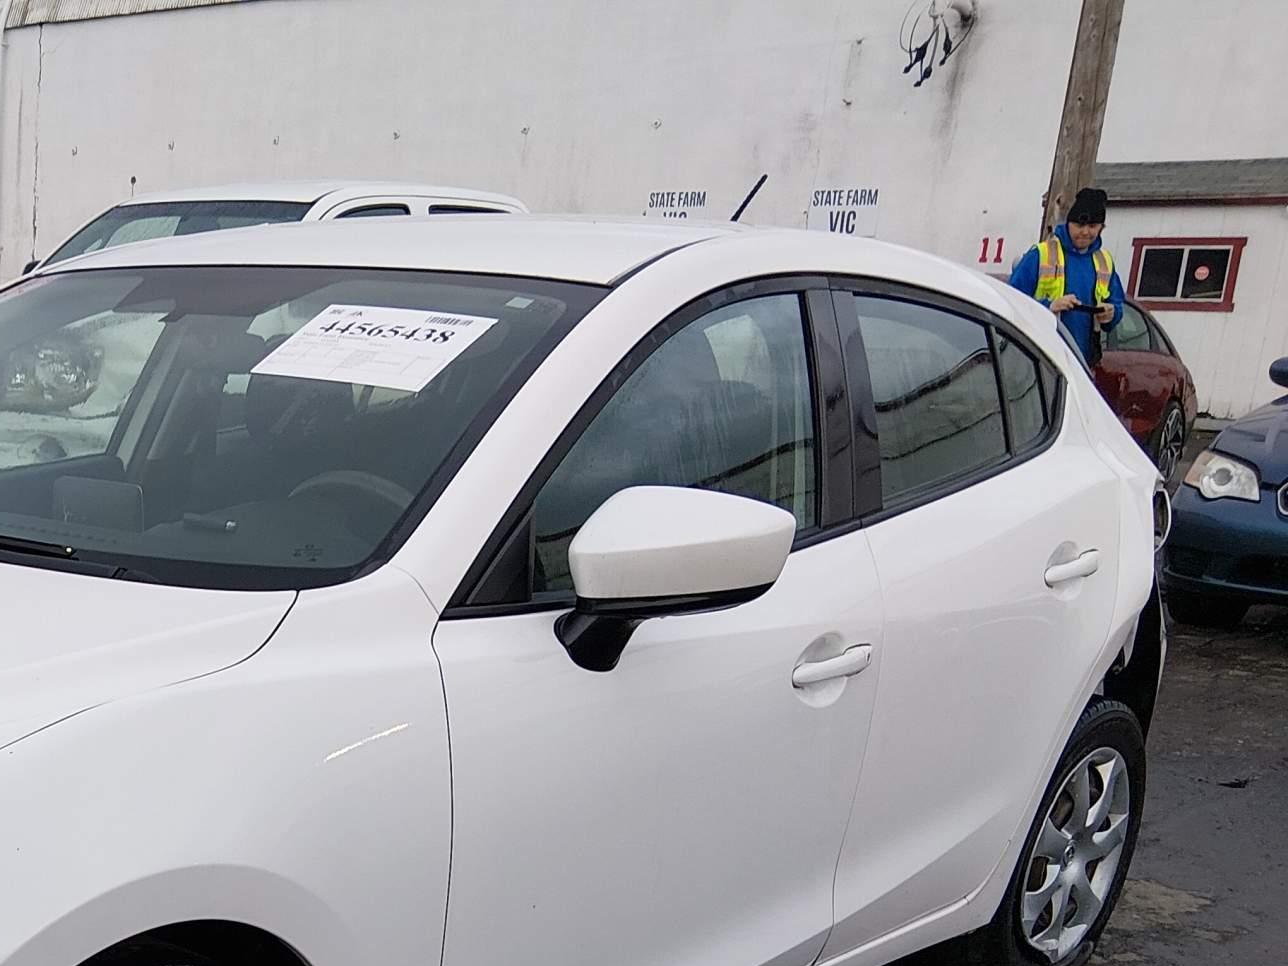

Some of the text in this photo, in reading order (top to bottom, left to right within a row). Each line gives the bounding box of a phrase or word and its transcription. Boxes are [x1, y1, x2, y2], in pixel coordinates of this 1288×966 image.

[649, 191, 706, 208] STATE FARM
[813, 189, 878, 207] STATE FARM
[830, 210, 856, 234] VIC
[978, 237, 1004, 263] 11
[319, 320, 456, 344] 44565438
